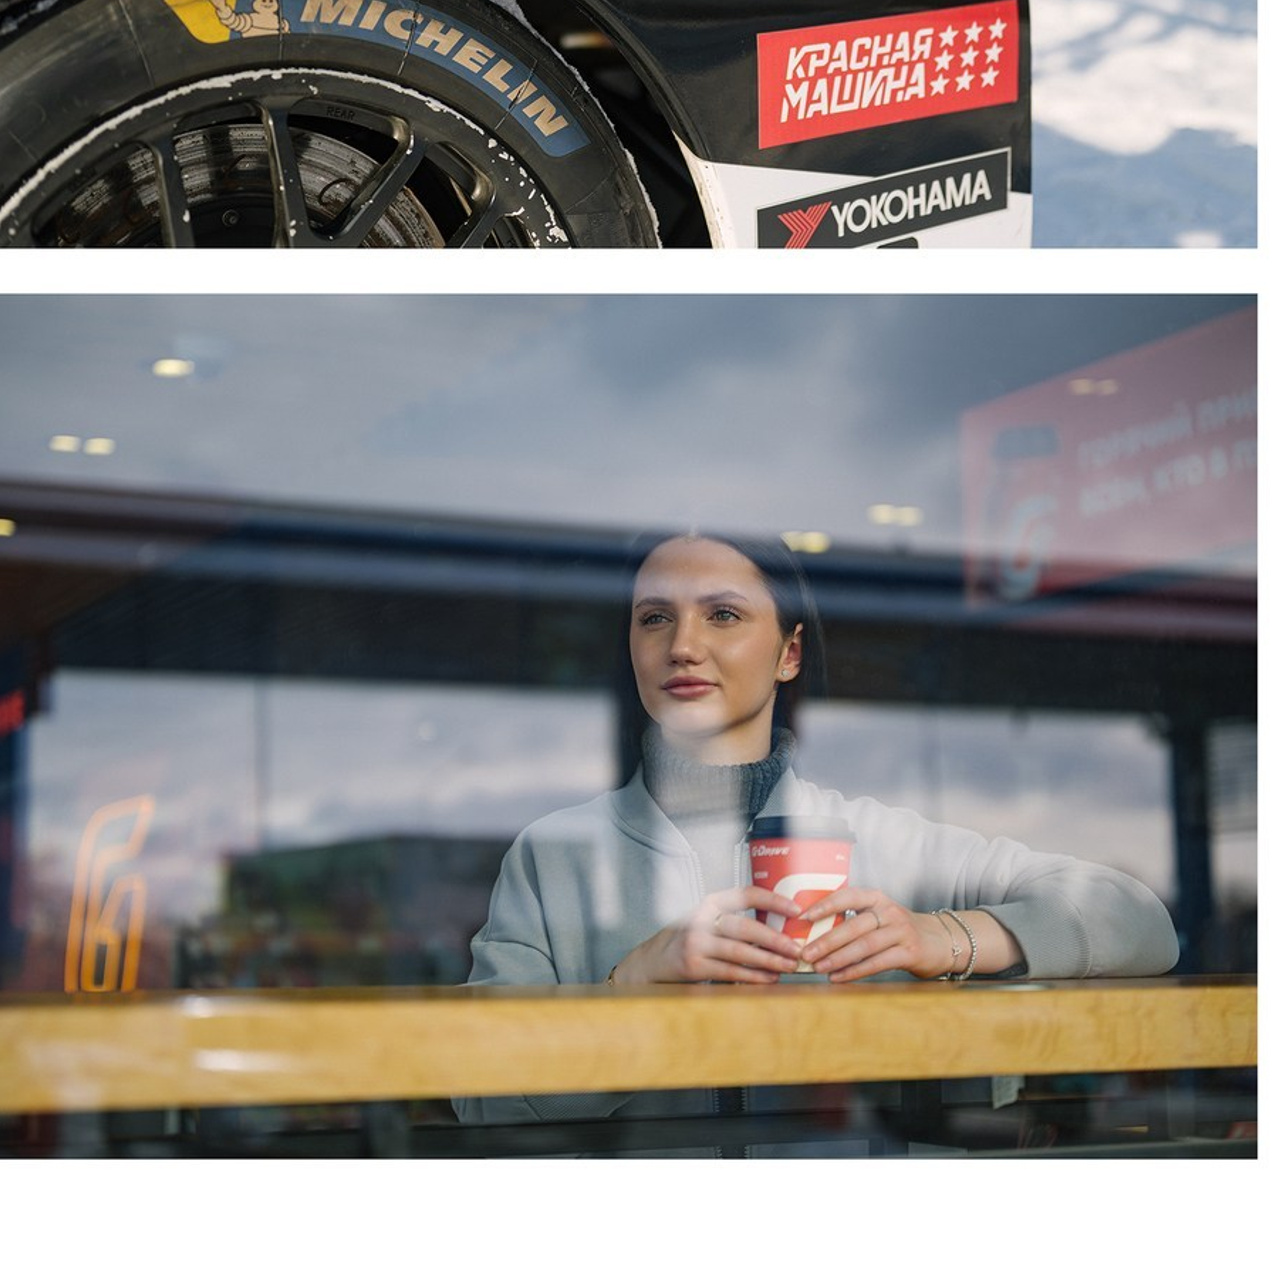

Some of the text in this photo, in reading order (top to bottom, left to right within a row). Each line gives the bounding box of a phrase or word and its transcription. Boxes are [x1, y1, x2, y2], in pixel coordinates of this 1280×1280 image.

[785, 27, 935, 81] КРАСНАЯ
[326, 105, 357, 121] REAR
[779, 62, 927, 123] МАШИНА
[830, 168, 992, 238] YOKOHAMA
